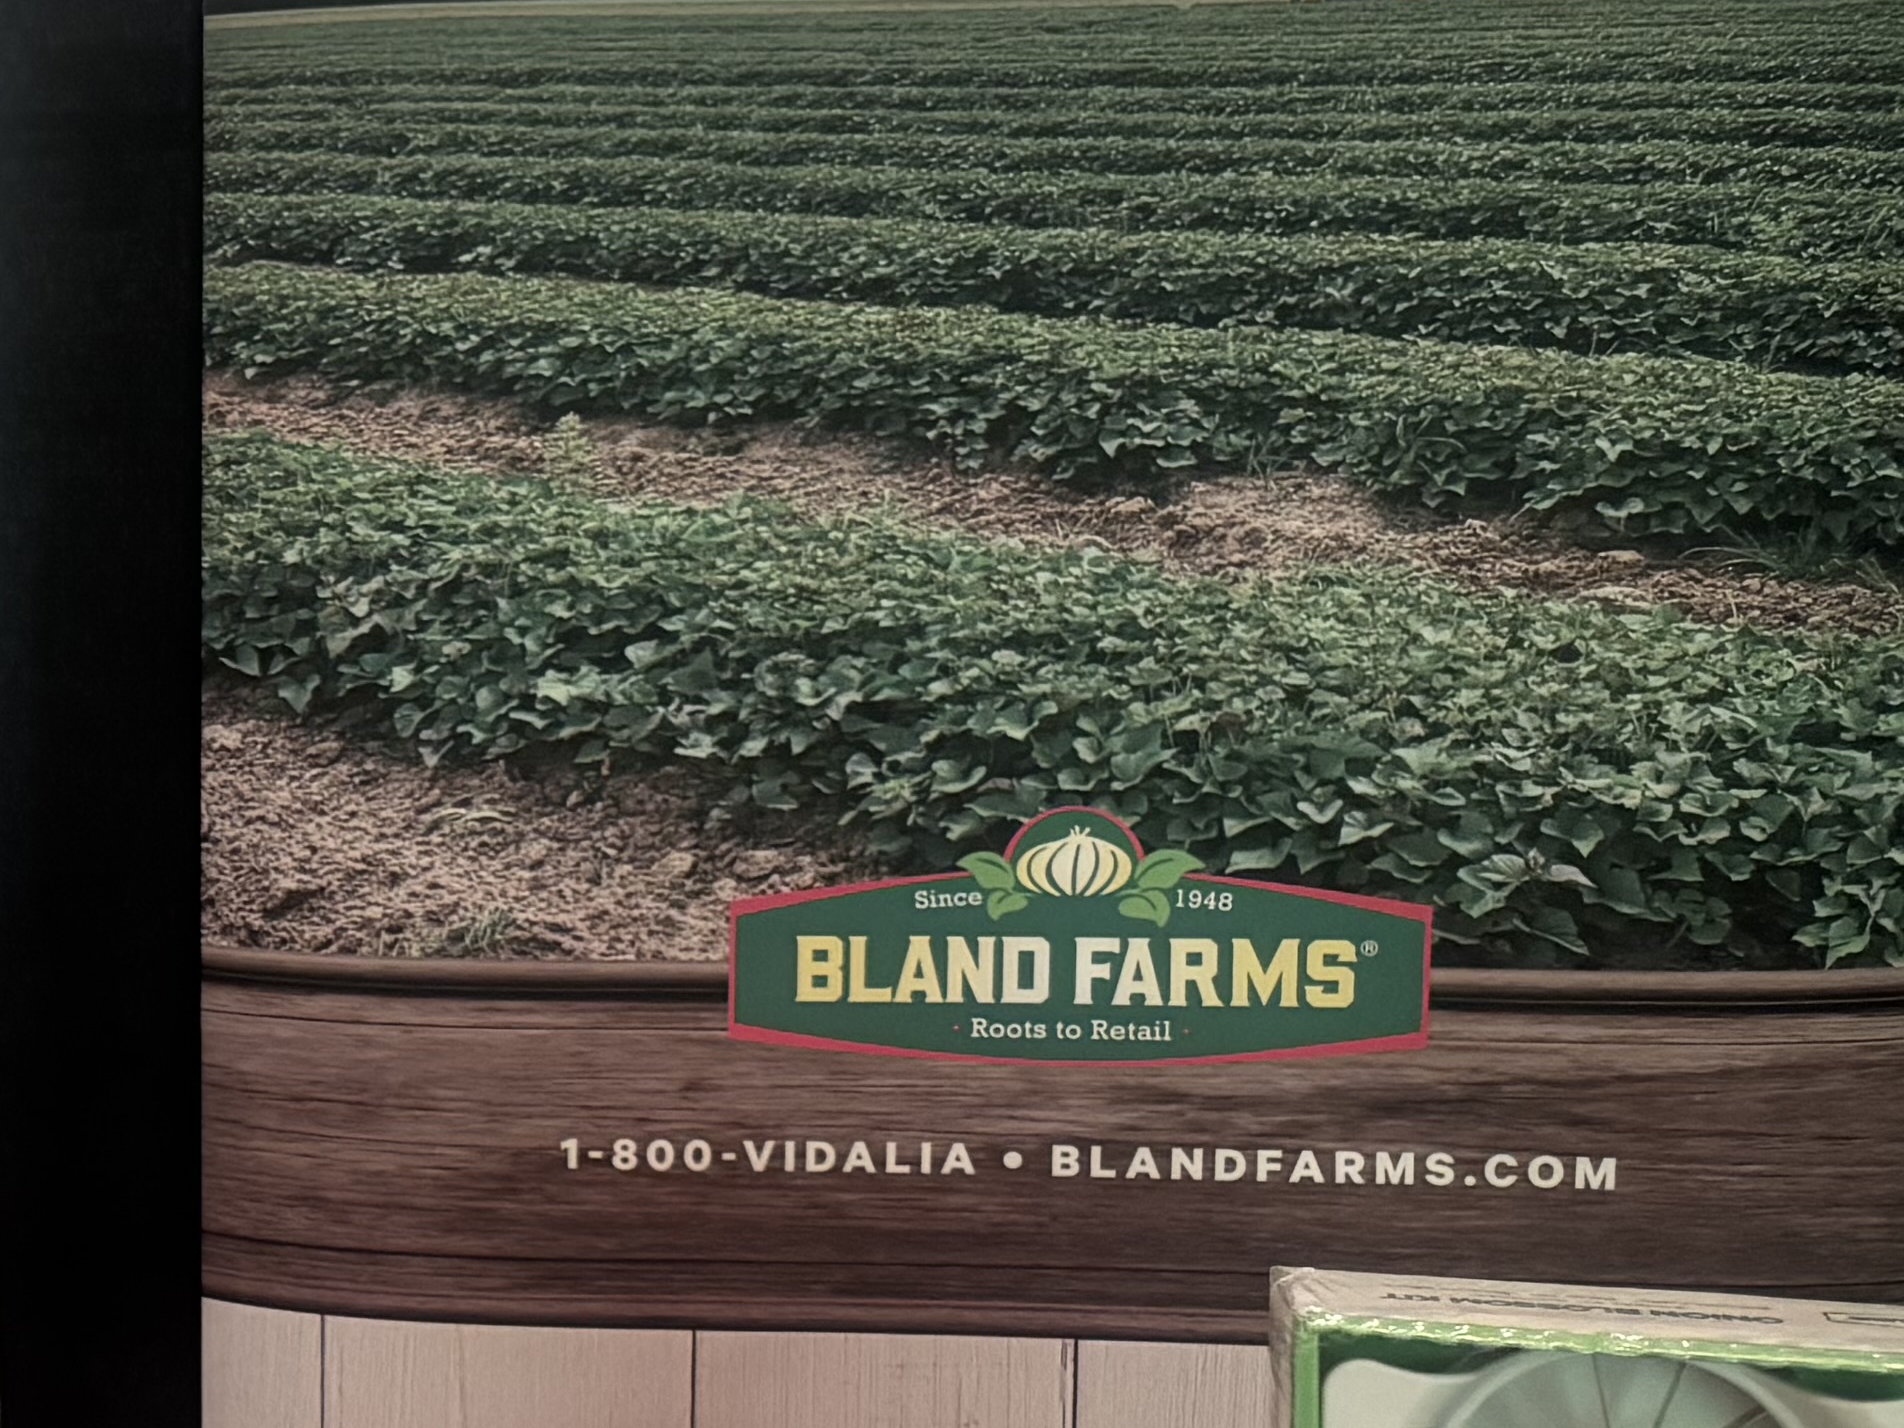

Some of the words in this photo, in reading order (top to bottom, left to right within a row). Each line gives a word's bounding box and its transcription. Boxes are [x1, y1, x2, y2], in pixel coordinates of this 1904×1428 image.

[913, 887, 983, 912] Since
[1174, 889, 1233, 913] 1948
[793, 933, 1051, 1005] BLAND
[969, 1017, 1045, 1042] Roots
[1054, 1019, 1082, 1041] to
[1091, 1018, 1172, 1043] Retail
[559, 1135, 977, 1177] 1-800-VIDALIA
[1049, 1143, 1618, 1191] BLANDFARMS.COM
